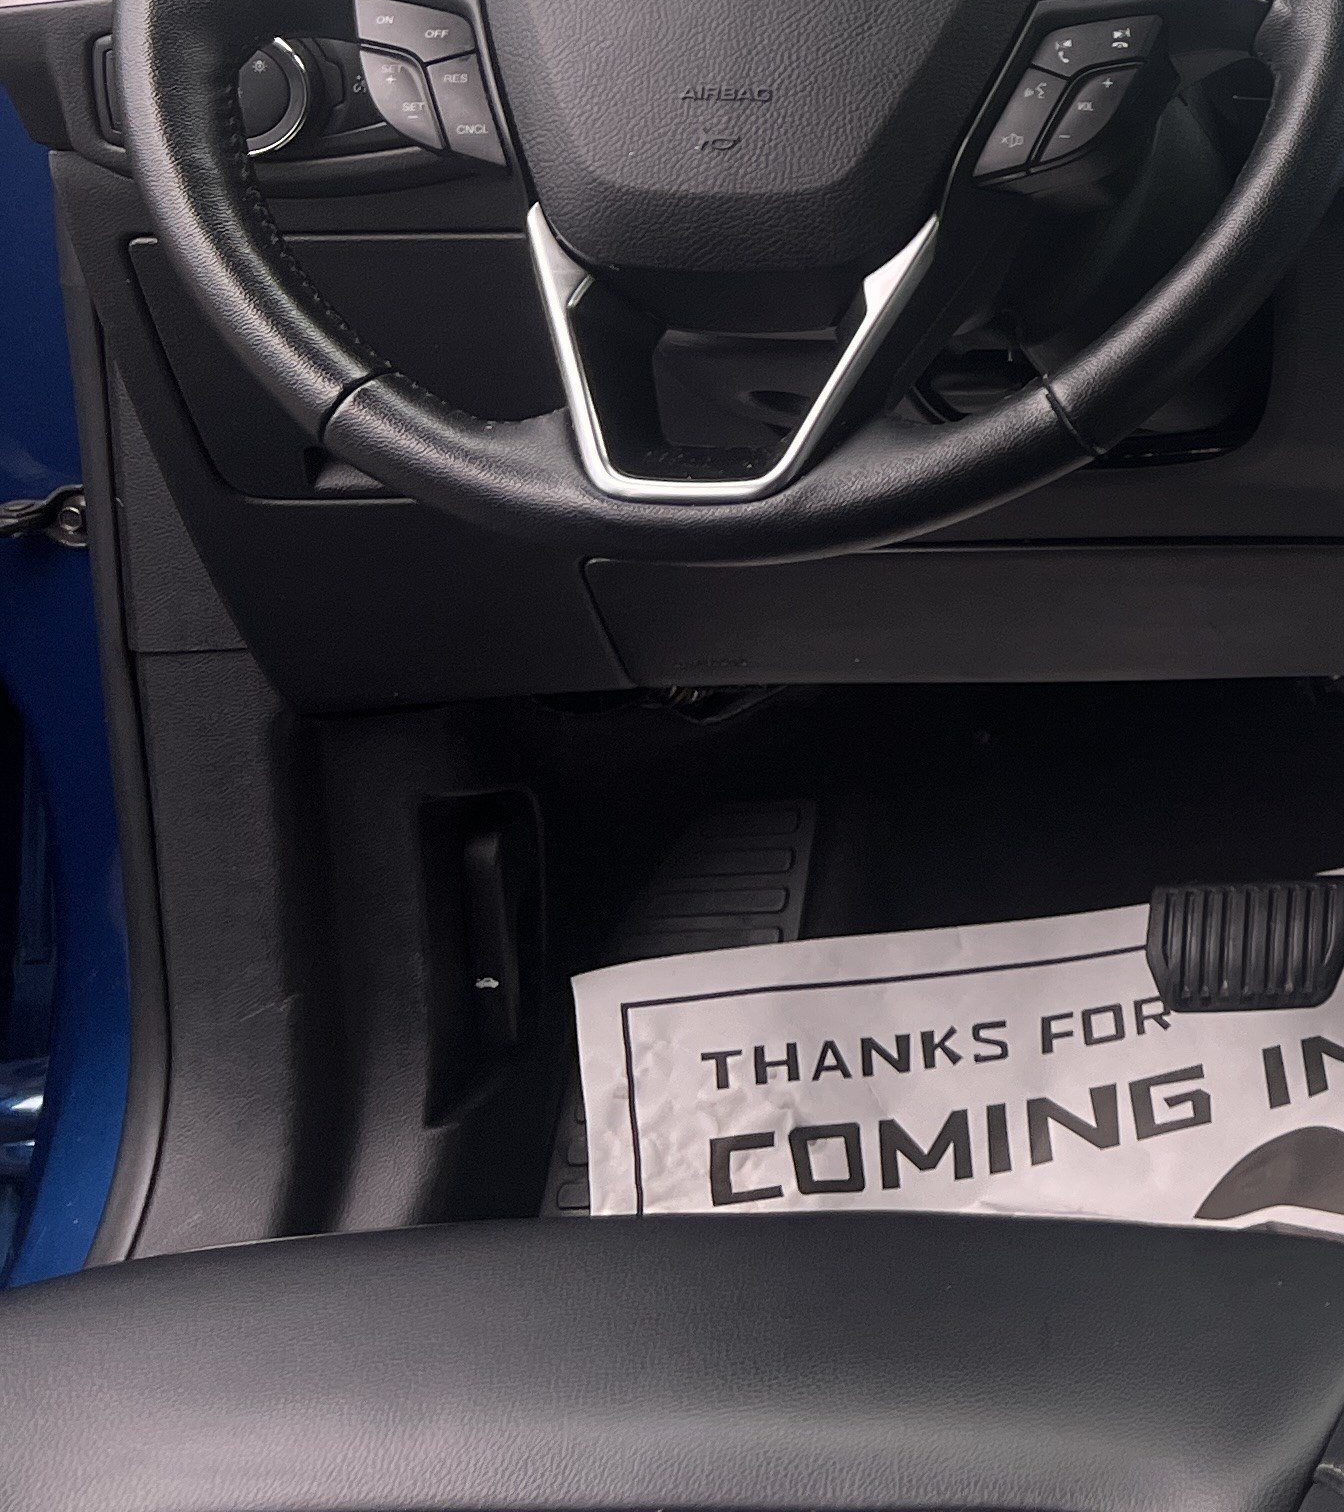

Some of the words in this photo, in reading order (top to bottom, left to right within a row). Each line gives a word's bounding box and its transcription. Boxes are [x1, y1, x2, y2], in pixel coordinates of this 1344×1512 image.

[376, 15, 394, 25] ON
[425, 29, 449, 39] OFF
[443, 74, 468, 83] RES
[402, 101, 425, 112] SET
[456, 124, 489, 135] CNCL
[701, 1018, 1009, 1090] THANKS
[1041, 994, 1172, 1055] FOR
[708, 1065, 1212, 1207] COMING
